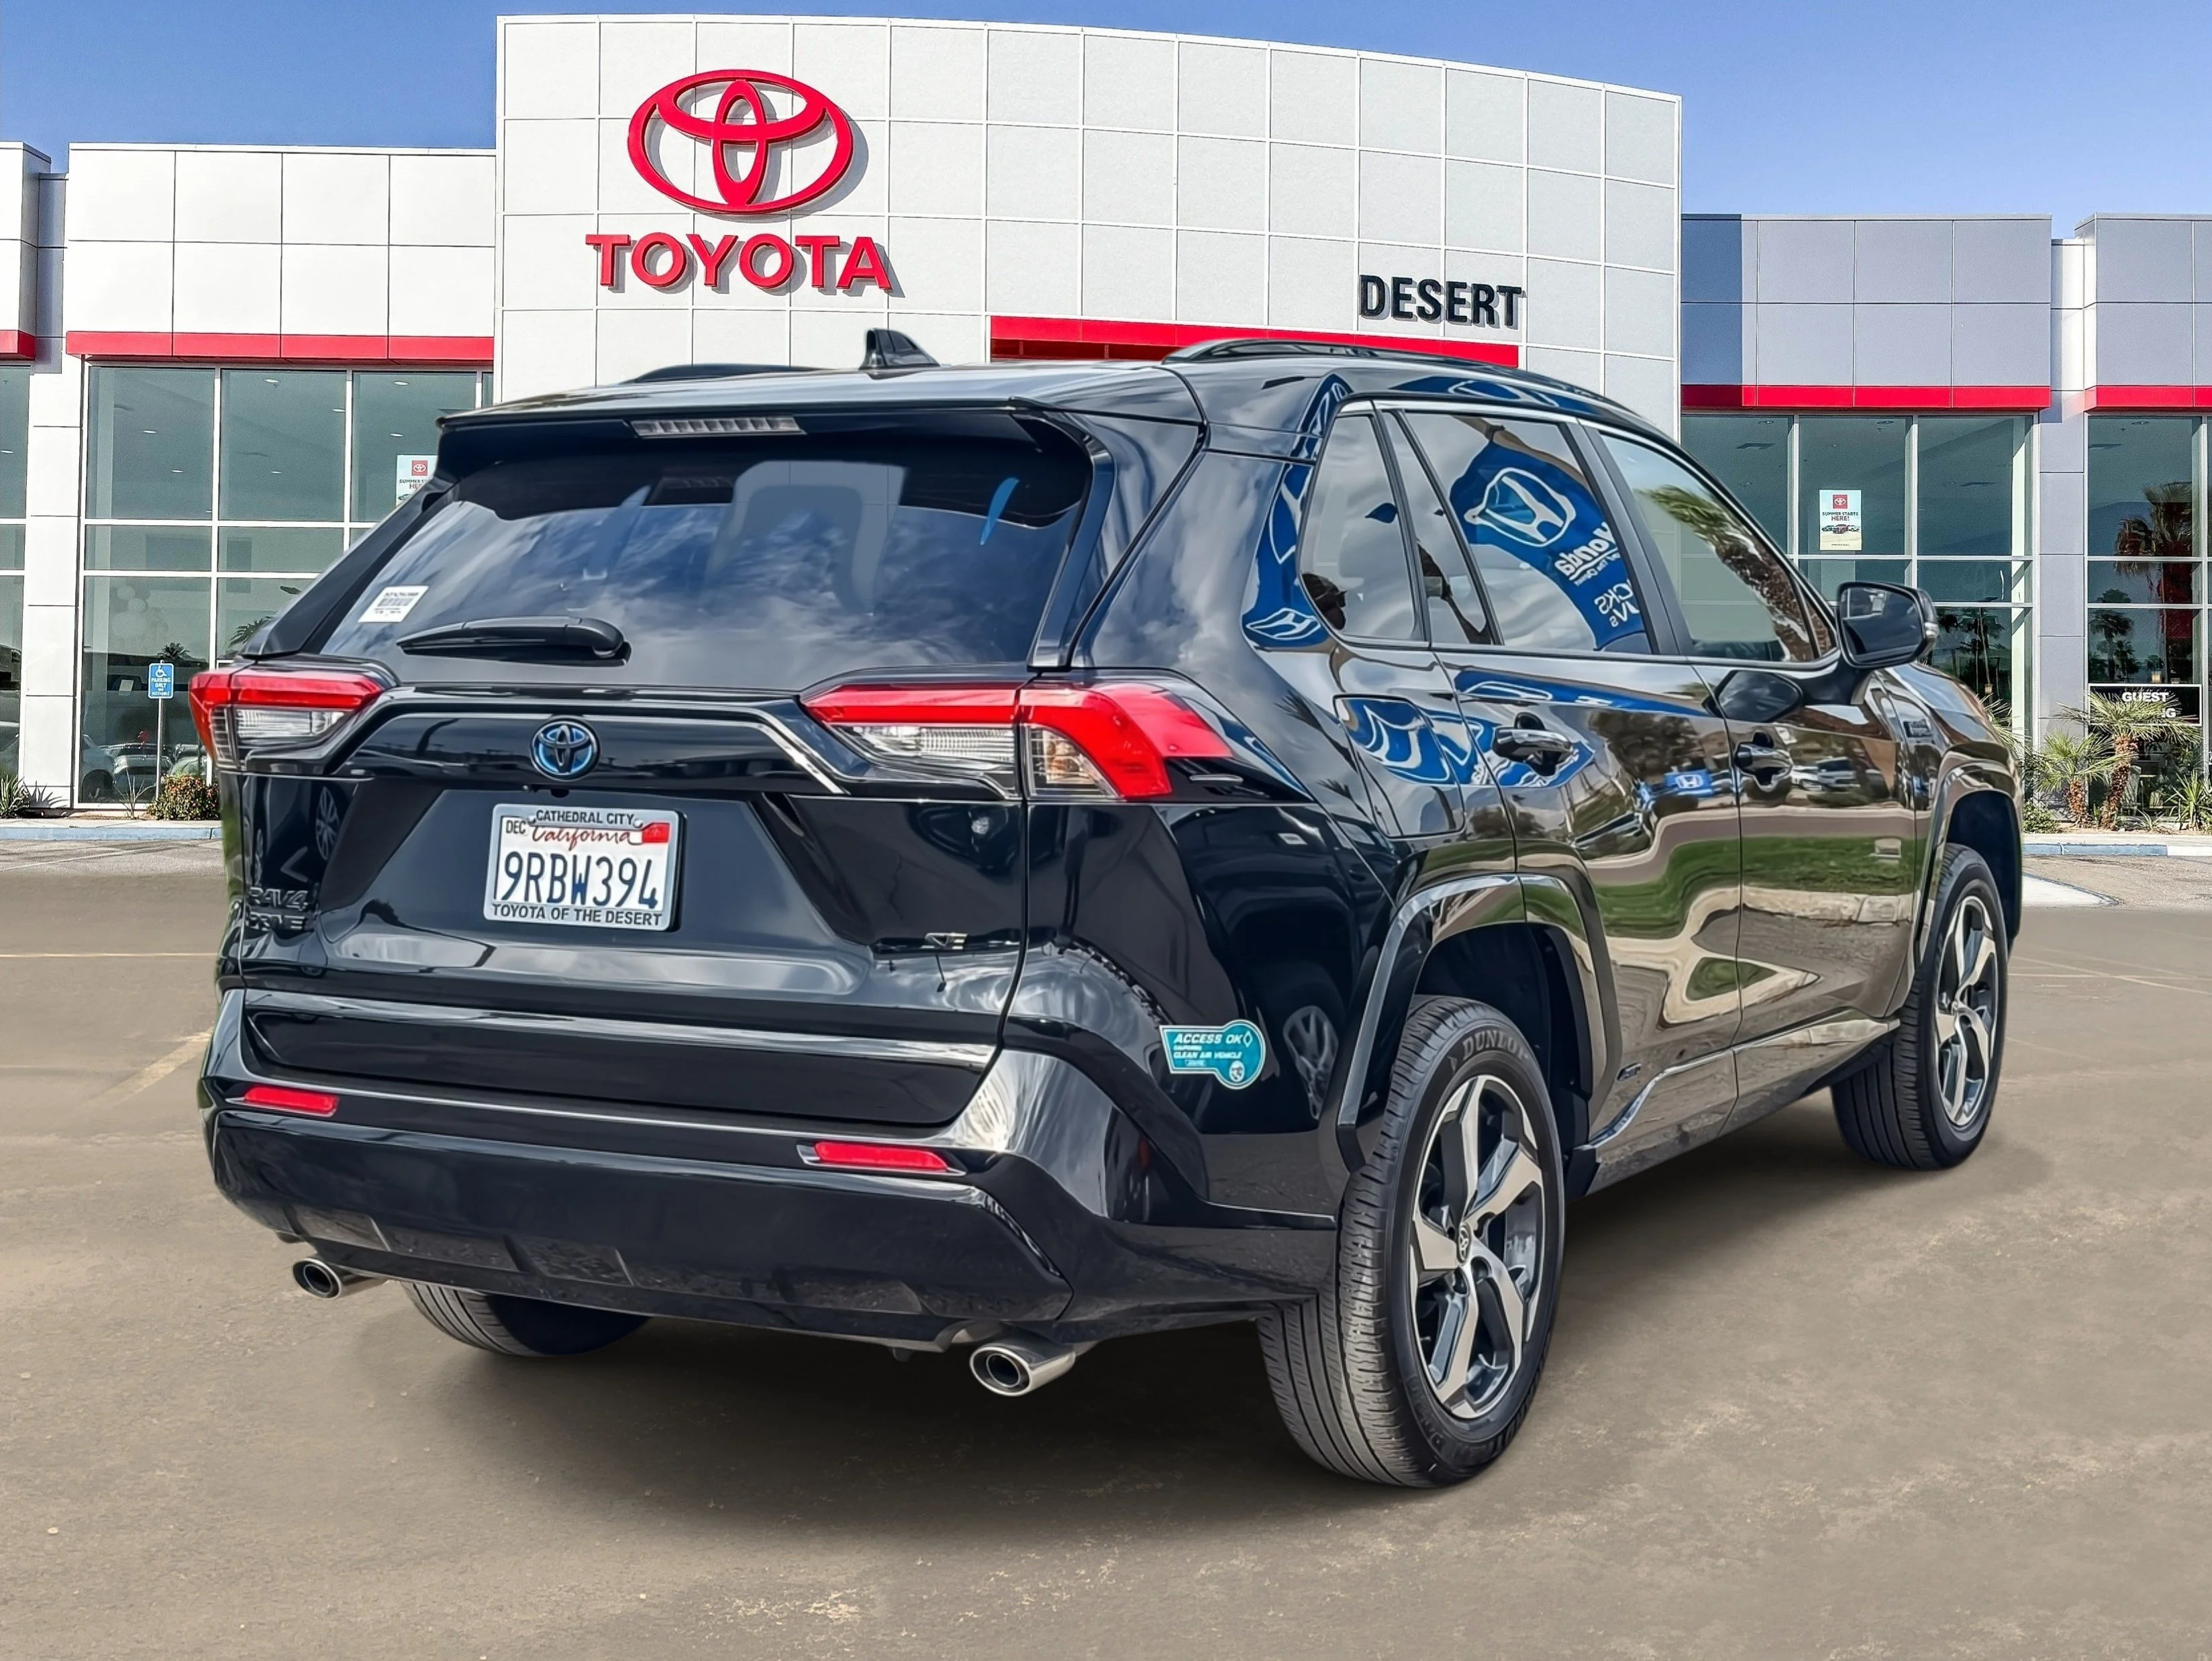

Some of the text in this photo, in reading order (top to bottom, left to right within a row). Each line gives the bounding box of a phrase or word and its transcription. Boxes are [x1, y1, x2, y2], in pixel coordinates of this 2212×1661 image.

[585, 232, 893, 291] TOYOTA
[1359, 274, 1522, 326] DESERT
[2121, 691, 2169, 702] GUEST
[536, 809, 634, 826] CATHEDRAL CITY
[505, 819, 644, 851] DEC California
[501, 851, 658, 909] 9RBW394
[248, 887, 309, 911] RAV4
[492, 903, 663, 926] TOYOTA OF THE DESERT
[1174, 1034, 1243, 1044] ACCESS OK
